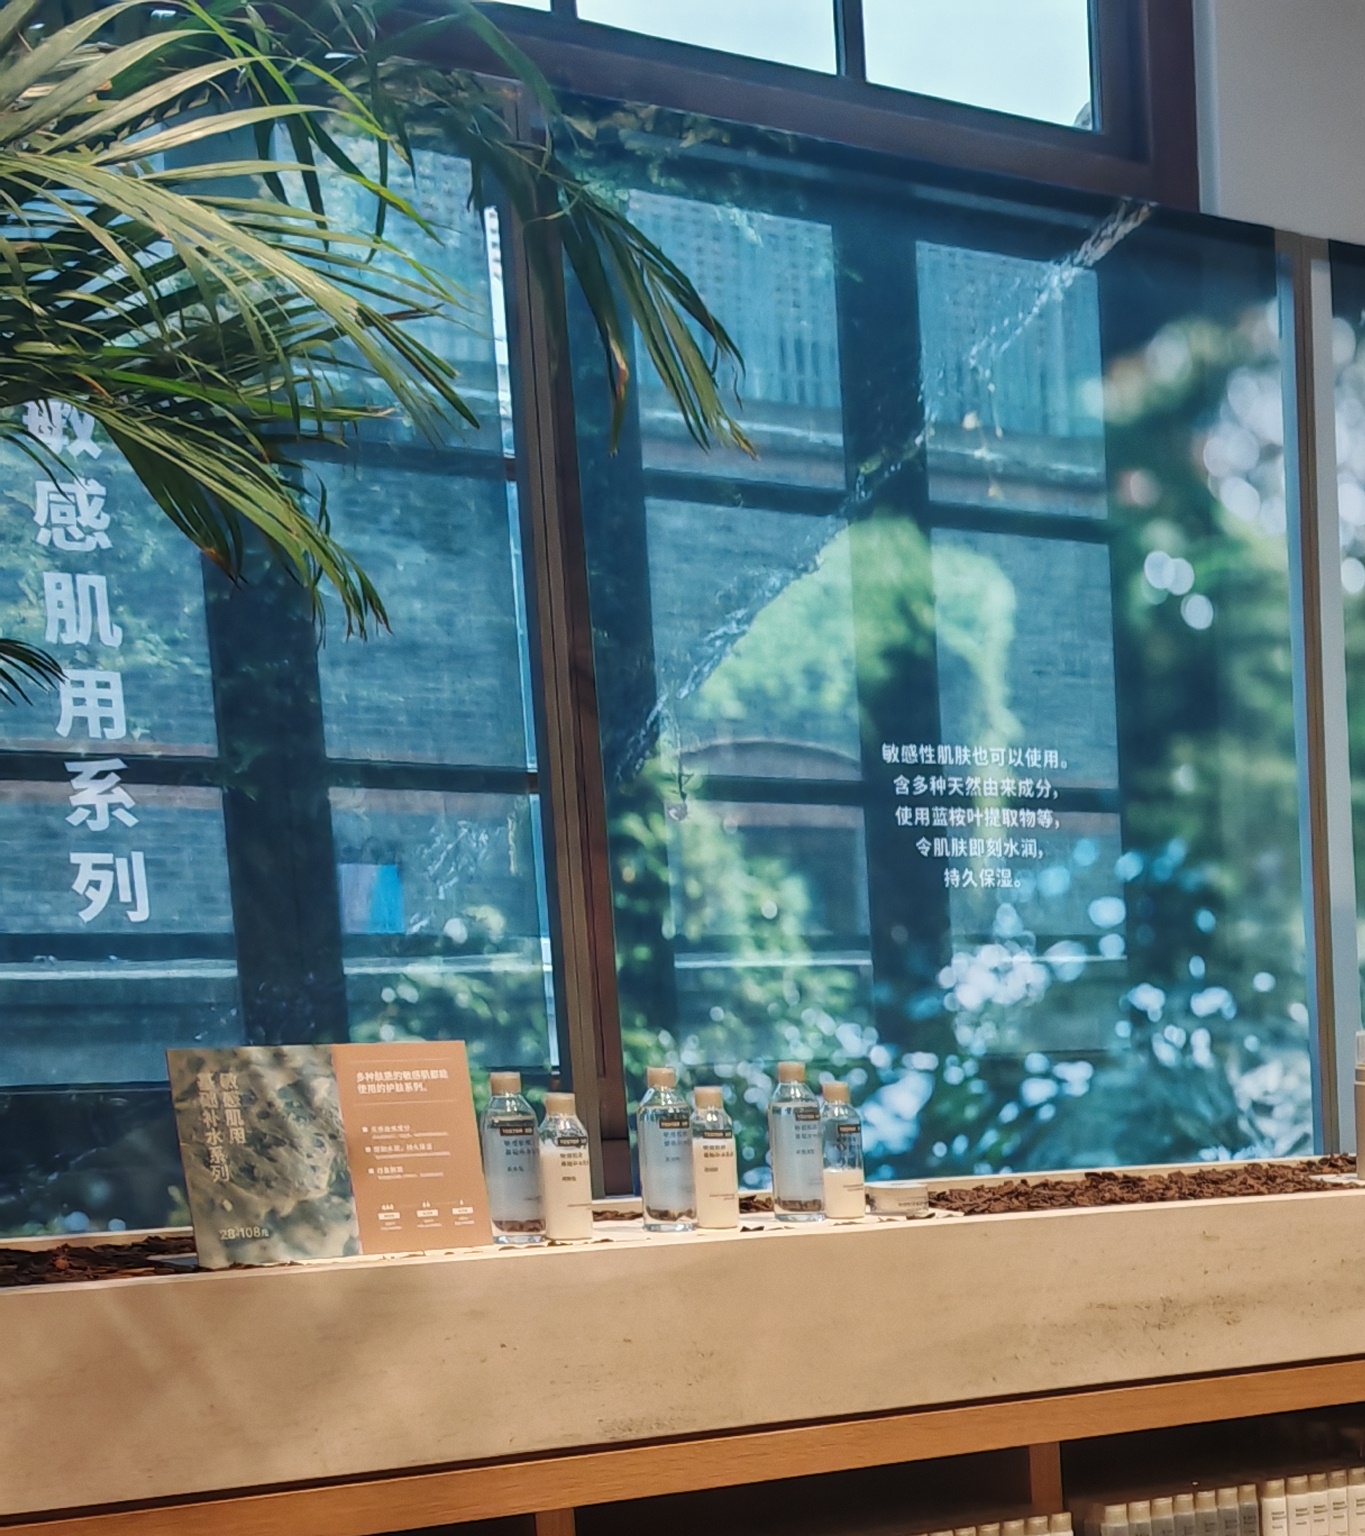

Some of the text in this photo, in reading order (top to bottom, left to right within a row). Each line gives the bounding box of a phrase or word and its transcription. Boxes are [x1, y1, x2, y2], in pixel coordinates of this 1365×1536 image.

[20, 398, 151, 923] 敏感肌用系列
[881, 743, 1068, 769] 敏感性肌肤也可以使用。
[893, 775, 1059, 799] 含多种天然由来成分，
[895, 806, 1060, 829] 使用蓝桉叶提取物等，
[916, 837, 1044, 859] 令肌肤即刻水润，
[943, 868, 1023, 888] 持久保湿。
